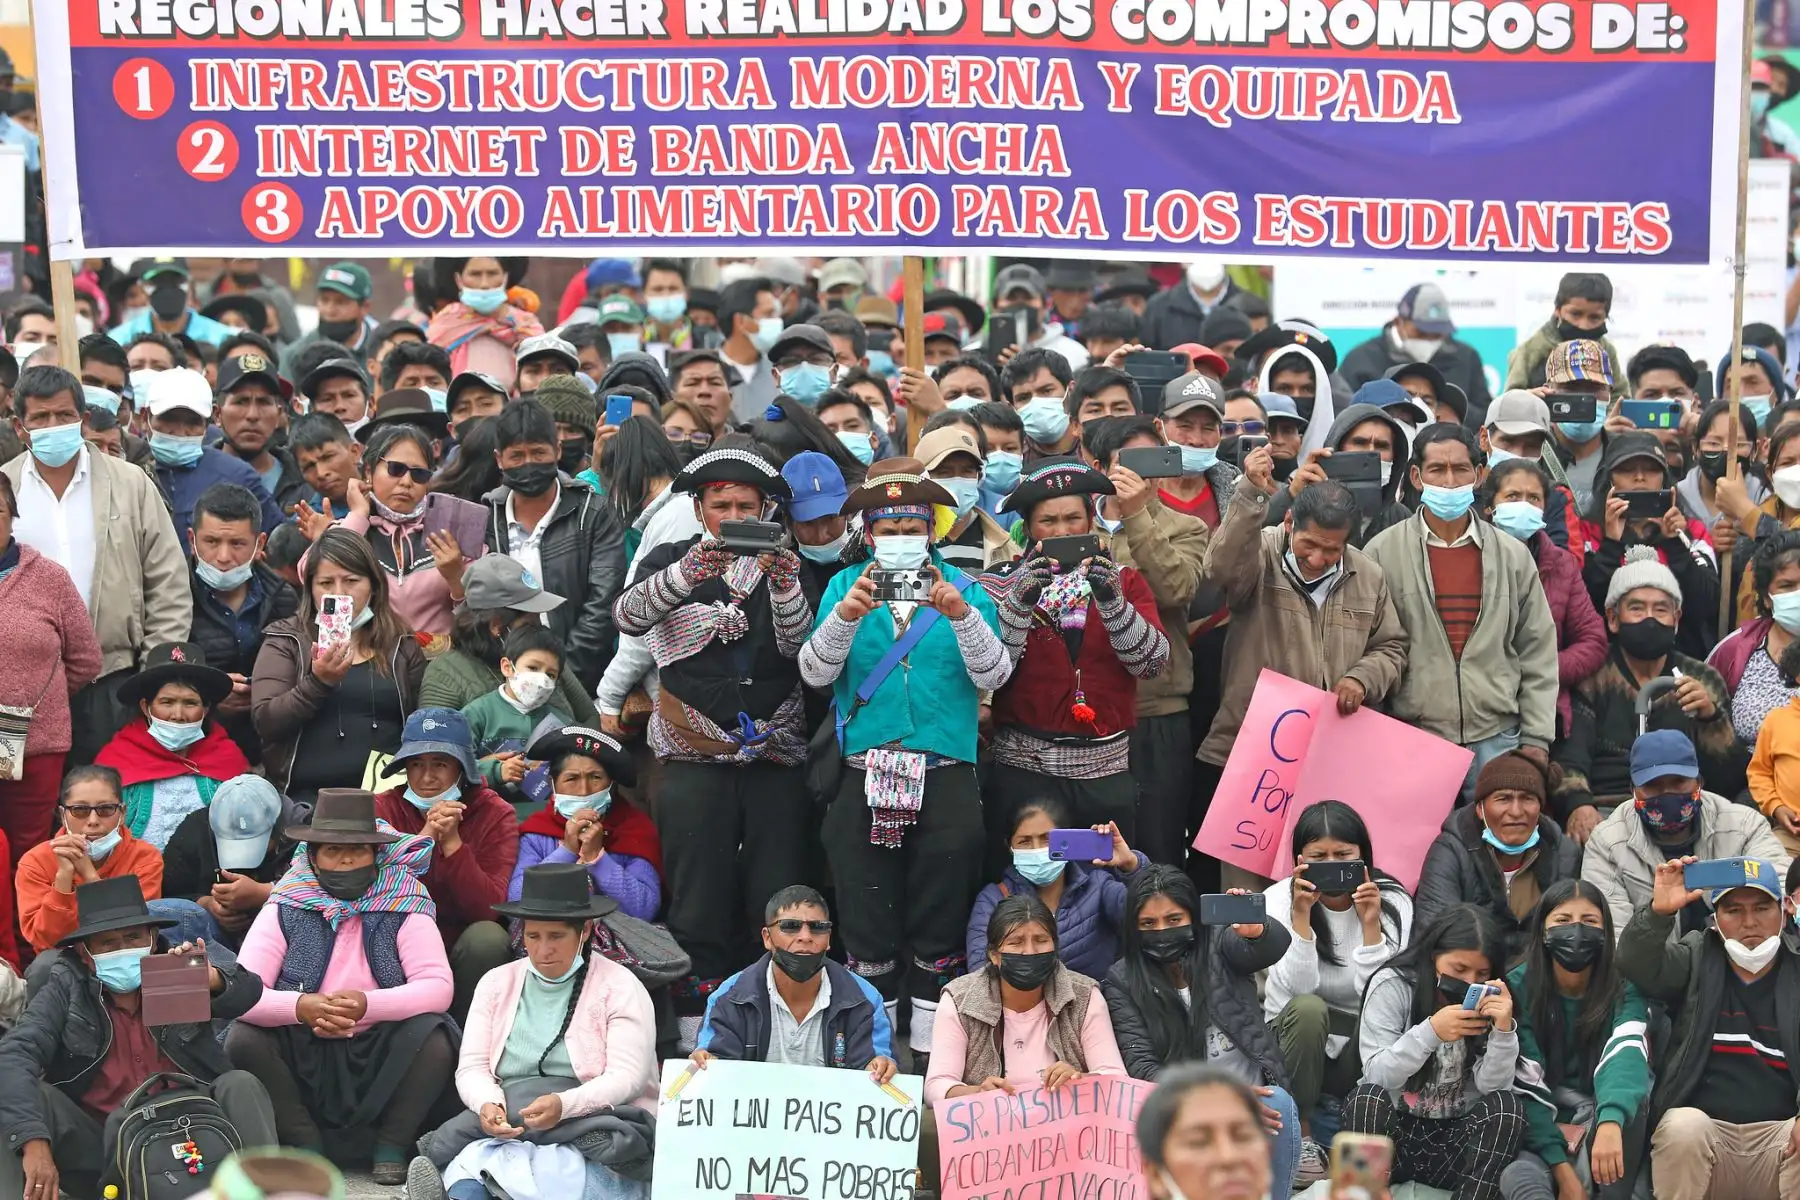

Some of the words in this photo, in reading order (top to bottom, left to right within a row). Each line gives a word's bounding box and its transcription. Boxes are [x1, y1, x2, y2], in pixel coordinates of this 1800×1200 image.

[98, 0, 464, 39] REGIONALES
[481, 0, 671, 38] HACER
[685, 0, 966, 36] REALIDAD
[981, 0, 1093, 38] LOS
[1110, 0, 1573, 52] COMPROMISOS
[1591, 2, 1688, 52] DE:
[189, 58, 777, 113] INFRAESTRUCTURA
[791, 55, 1083, 112] MODERNA
[1099, 60, 1138, 114] Y
[1153, 64, 1462, 128] EQUIPADA
[190, 127, 226, 173] 2
[255, 125, 547, 179] INTERNET
[559, 125, 638, 178] DE
[650, 123, 856, 177] BANDA
[868, 122, 1071, 178] ANCHA
[253, 190, 290, 236] 3
[315, 187, 526, 240] APOYO
[538, 183, 944, 239] ALIMENTARIO
[952, 184, 1108, 242] PARA
[1122, 187, 1242, 246] LOS
[1252, 193, 1674, 255] ESTUDIANTES
[1182, 388, 1217, 400] adidas
[676, 1098, 714, 1127] EN
[732, 1098, 769, 1129] UN
[784, 1098, 842, 1135] PAIS
[855, 1104, 919, 1143] RICO
[946, 1100, 990, 1144] SR.
[994, 1079, 1145, 1136] PRESIDENTE
[695, 1156, 732, 1191] NO
[747, 1156, 809, 1196] MAS
[822, 1160, 916, 1200] POBRES
[940, 1132, 1069, 1196] ACOBAMBA
[1077, 1125, 1145, 1175] QUIER
